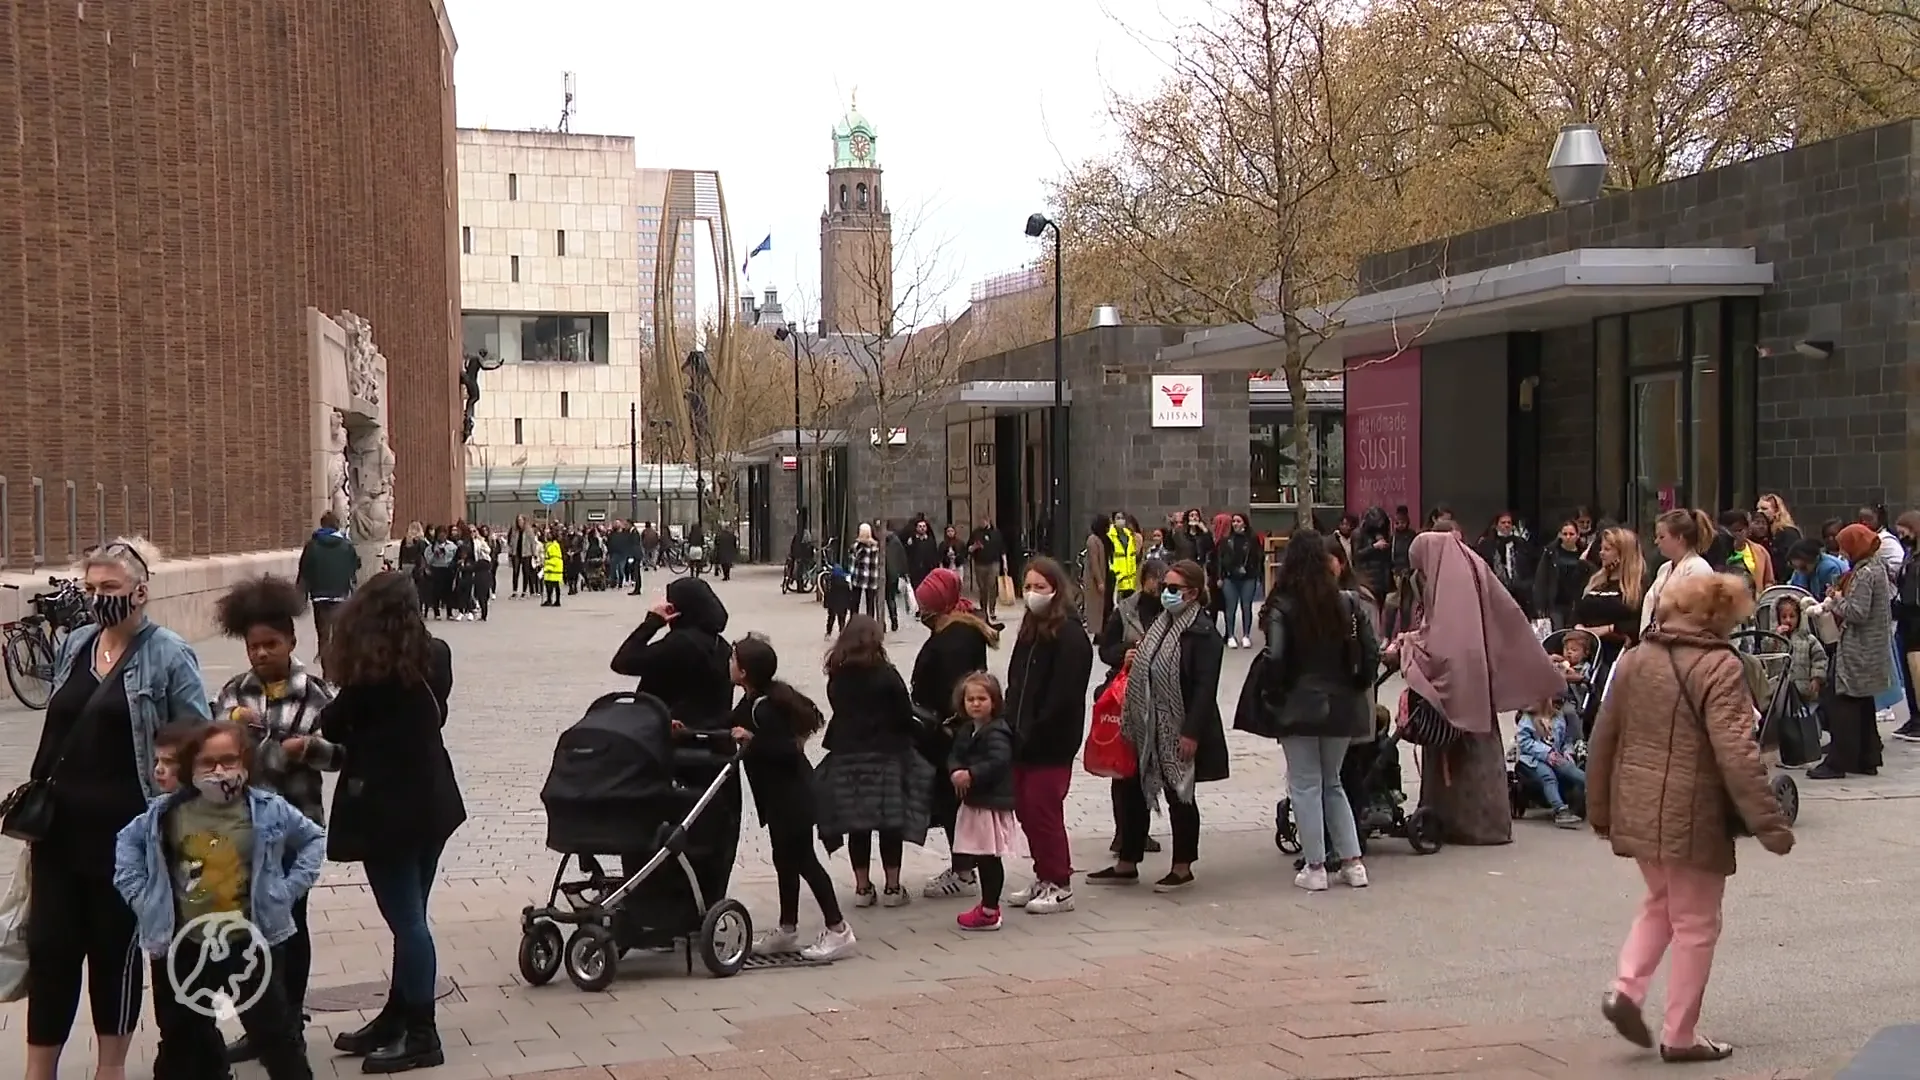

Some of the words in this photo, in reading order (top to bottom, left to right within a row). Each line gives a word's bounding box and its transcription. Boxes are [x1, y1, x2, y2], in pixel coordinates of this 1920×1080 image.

[1158, 411, 1198, 421] AJISAN
[1358, 411, 1407, 433] Handmade
[1359, 437, 1406, 470] SUSHI
[1359, 474, 1406, 495] throughout
